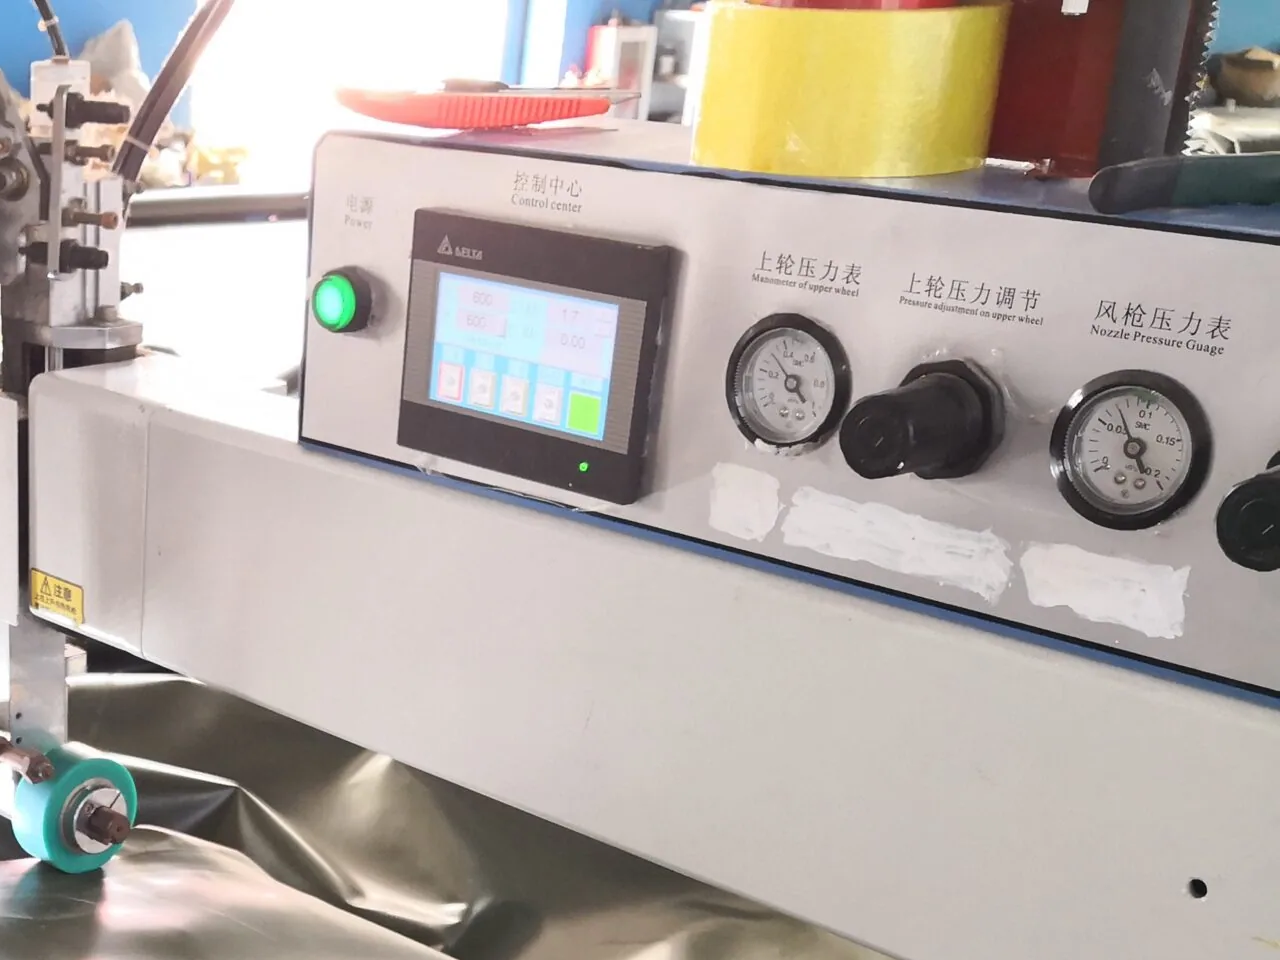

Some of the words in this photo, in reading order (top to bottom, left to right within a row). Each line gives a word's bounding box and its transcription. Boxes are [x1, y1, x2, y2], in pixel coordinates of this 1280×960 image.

[513, 170, 582, 198] 控制中心
[346, 193, 375, 215] 电源
[511, 193, 549, 210] Control
[551, 198, 582, 213] center
[344, 214, 373, 230] Power
[755, 250, 862, 285] 上轮压力表
[752, 273, 796, 288] Manometer
[798, 281, 808, 289] of
[809, 283, 833, 294] upper
[834, 286, 859, 297] wheel
[902, 272, 1041, 312] 上轮压力调节
[473, 291, 493, 306] 600
[899, 295, 932, 309] Pressure
[933, 302, 978, 316] adjustment
[980, 309, 990, 318] on
[992, 311, 1016, 322] upper
[1018, 315, 1043, 326] wheel
[1094, 300, 1232, 340] 风枪压力表
[1090, 324, 1130, 340] Nozzle
[1132, 331, 1183, 348] Pressure
[1186, 339, 1225, 356] Guage
[1156, 434, 1176, 446] 0.15
